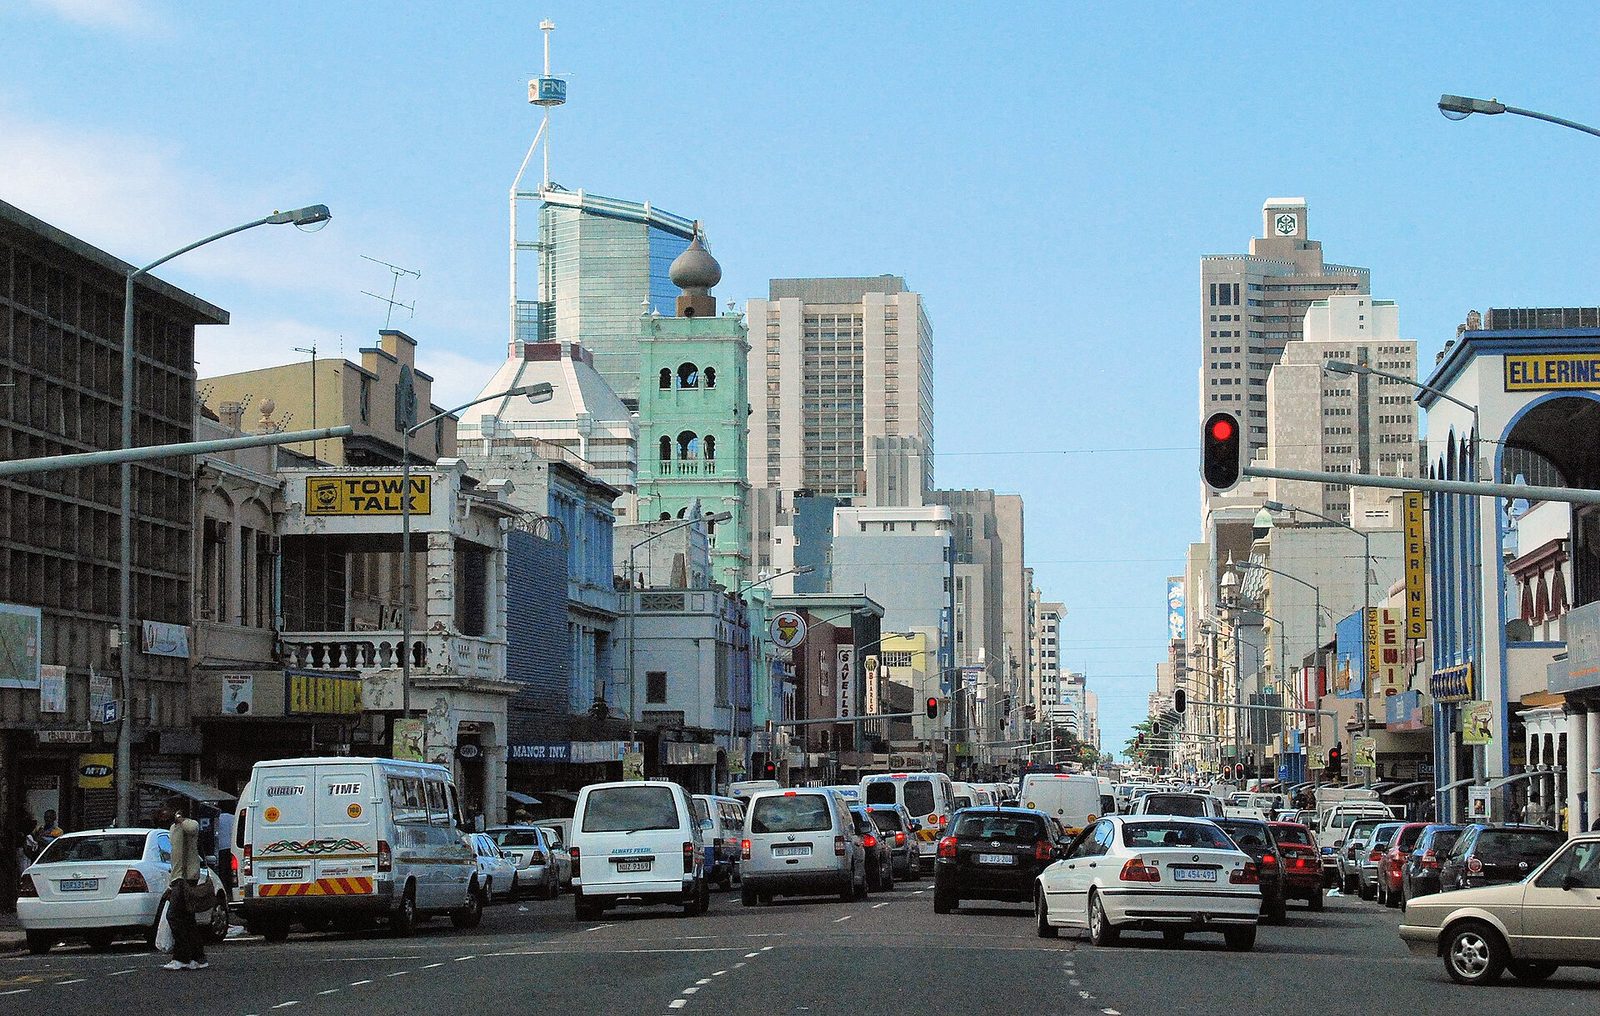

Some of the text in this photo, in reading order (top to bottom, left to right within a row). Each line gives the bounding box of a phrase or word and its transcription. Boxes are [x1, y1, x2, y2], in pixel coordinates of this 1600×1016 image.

[1509, 360, 1600, 384] ELLERINE
[345, 479, 426, 494] TOWN
[349, 496, 417, 511] TALK
[1409, 497, 1421, 634] ELLERINES
[841, 653, 850, 718] SAVELLS
[512, 745, 546, 758] MANOR
[266, 783, 360, 797] QUALITY TIME
[1176, 870, 1215, 880] ND 454-491
